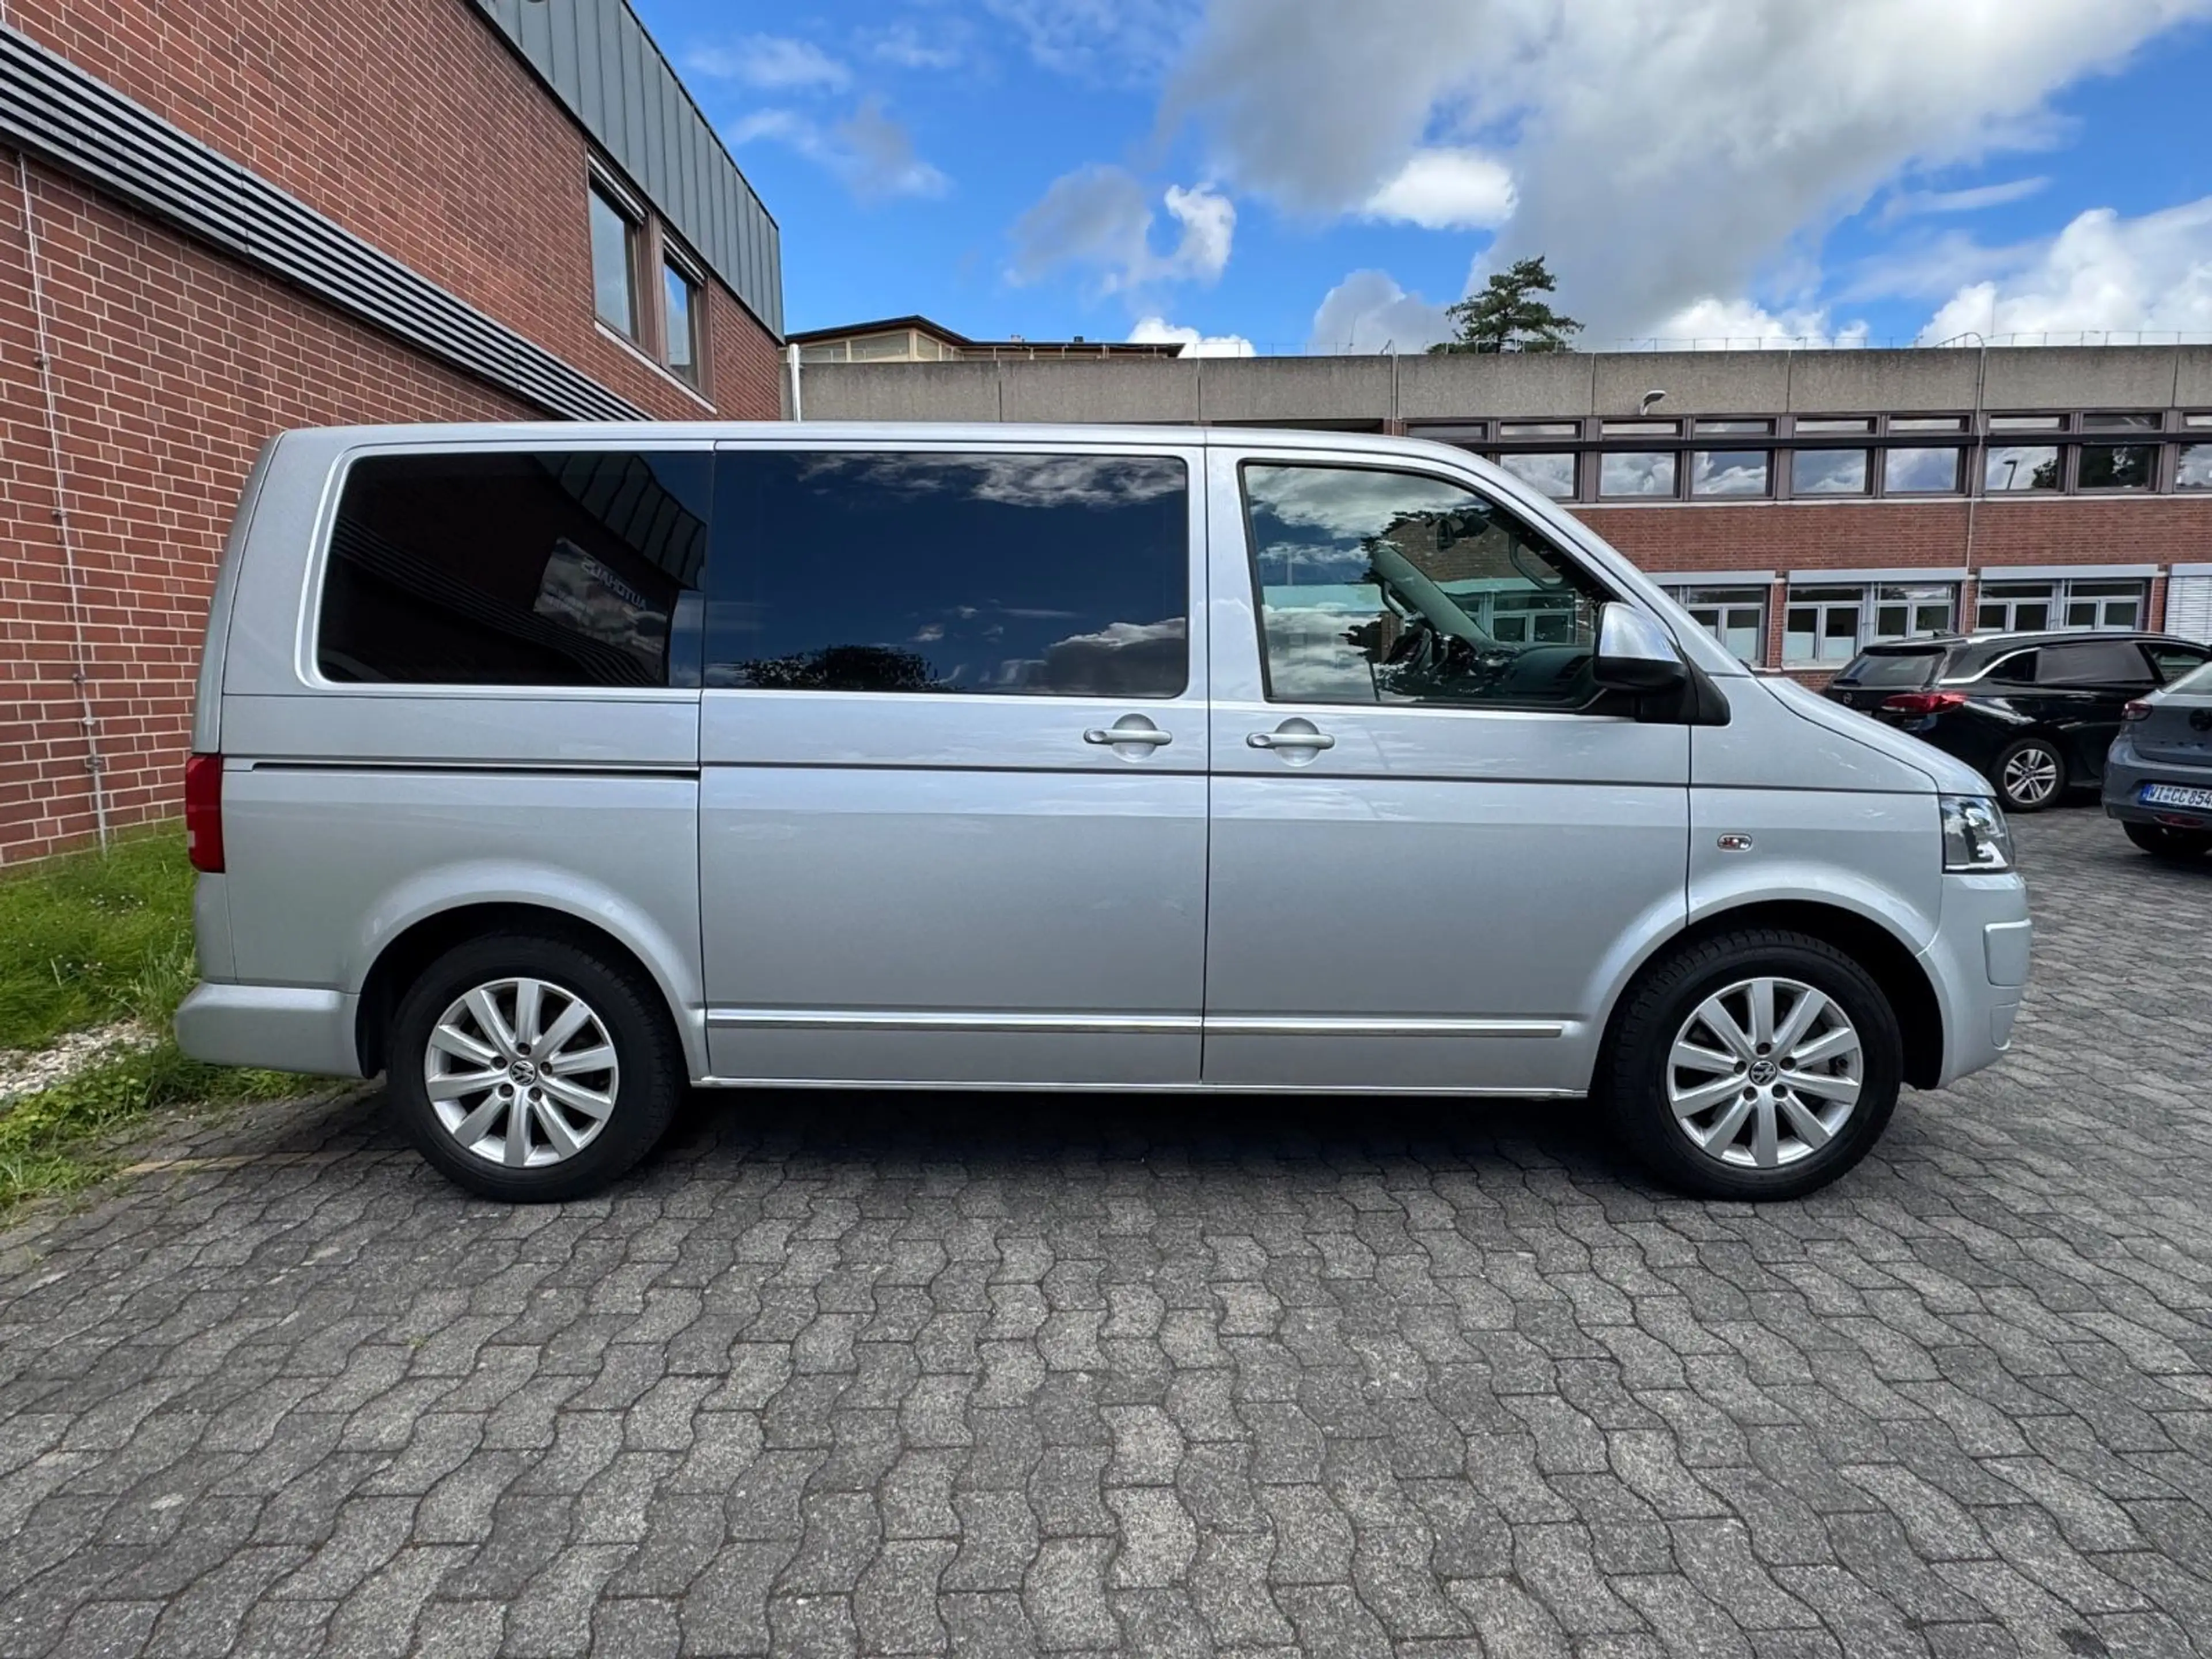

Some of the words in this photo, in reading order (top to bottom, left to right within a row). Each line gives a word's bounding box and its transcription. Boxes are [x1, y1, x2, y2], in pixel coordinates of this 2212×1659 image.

[2149, 785, 2164, 800] WI
[2171, 787, 2188, 803] CC
[2188, 790, 2212, 806] 854
